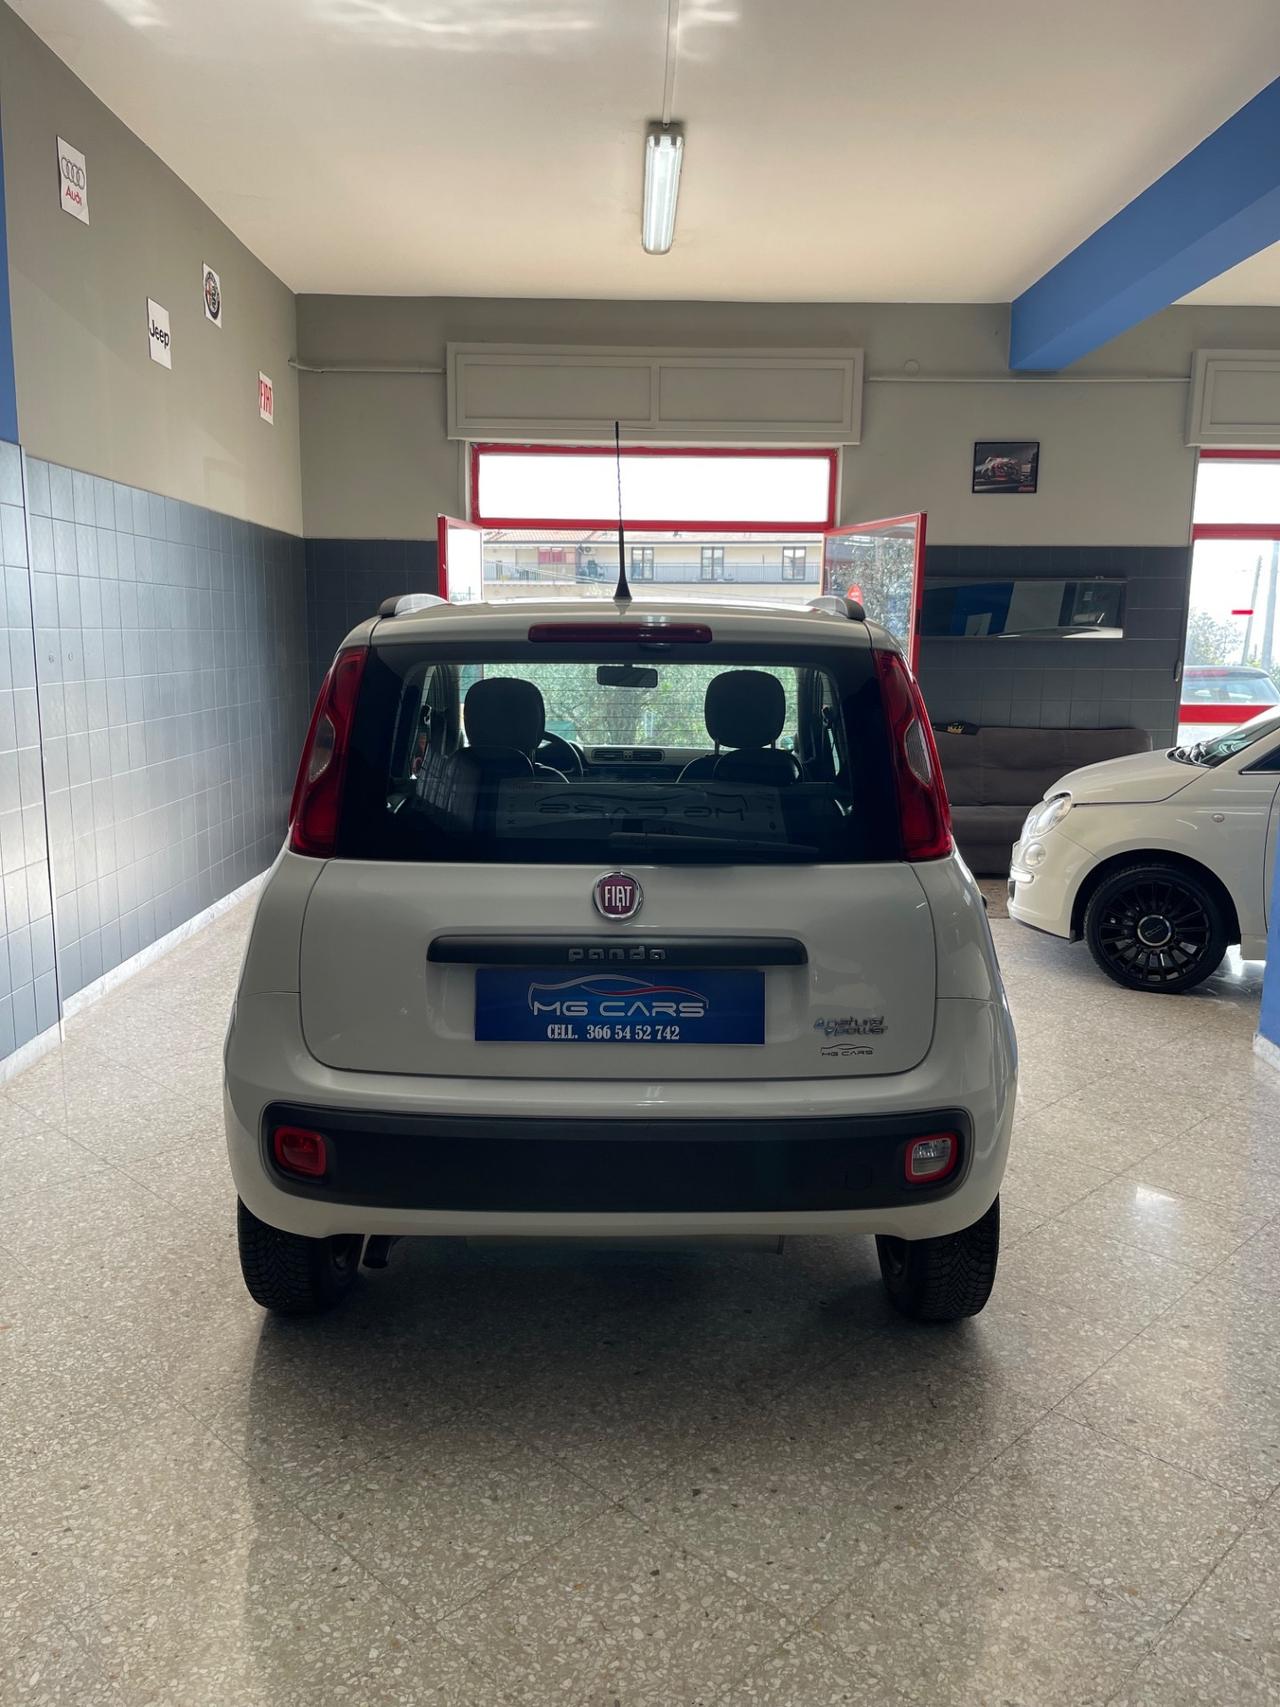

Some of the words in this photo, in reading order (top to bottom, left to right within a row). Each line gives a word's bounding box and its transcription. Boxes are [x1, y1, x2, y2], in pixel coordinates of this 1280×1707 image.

[65, 185, 82, 206] Audi
[150, 320, 169, 349] Jeep
[604, 885, 632, 911] FIAT
[568, 946, 666, 962] panda
[533, 1001, 589, 1017] MG
[600, 1001, 705, 1017] CARS
[547, 1023, 578, 1039] CELL.
[586, 1024, 611, 1040] 366
[614, 1024, 631, 1040] 54
[635, 1024, 651, 1040] 52
[655, 1024, 680, 1040] 742
